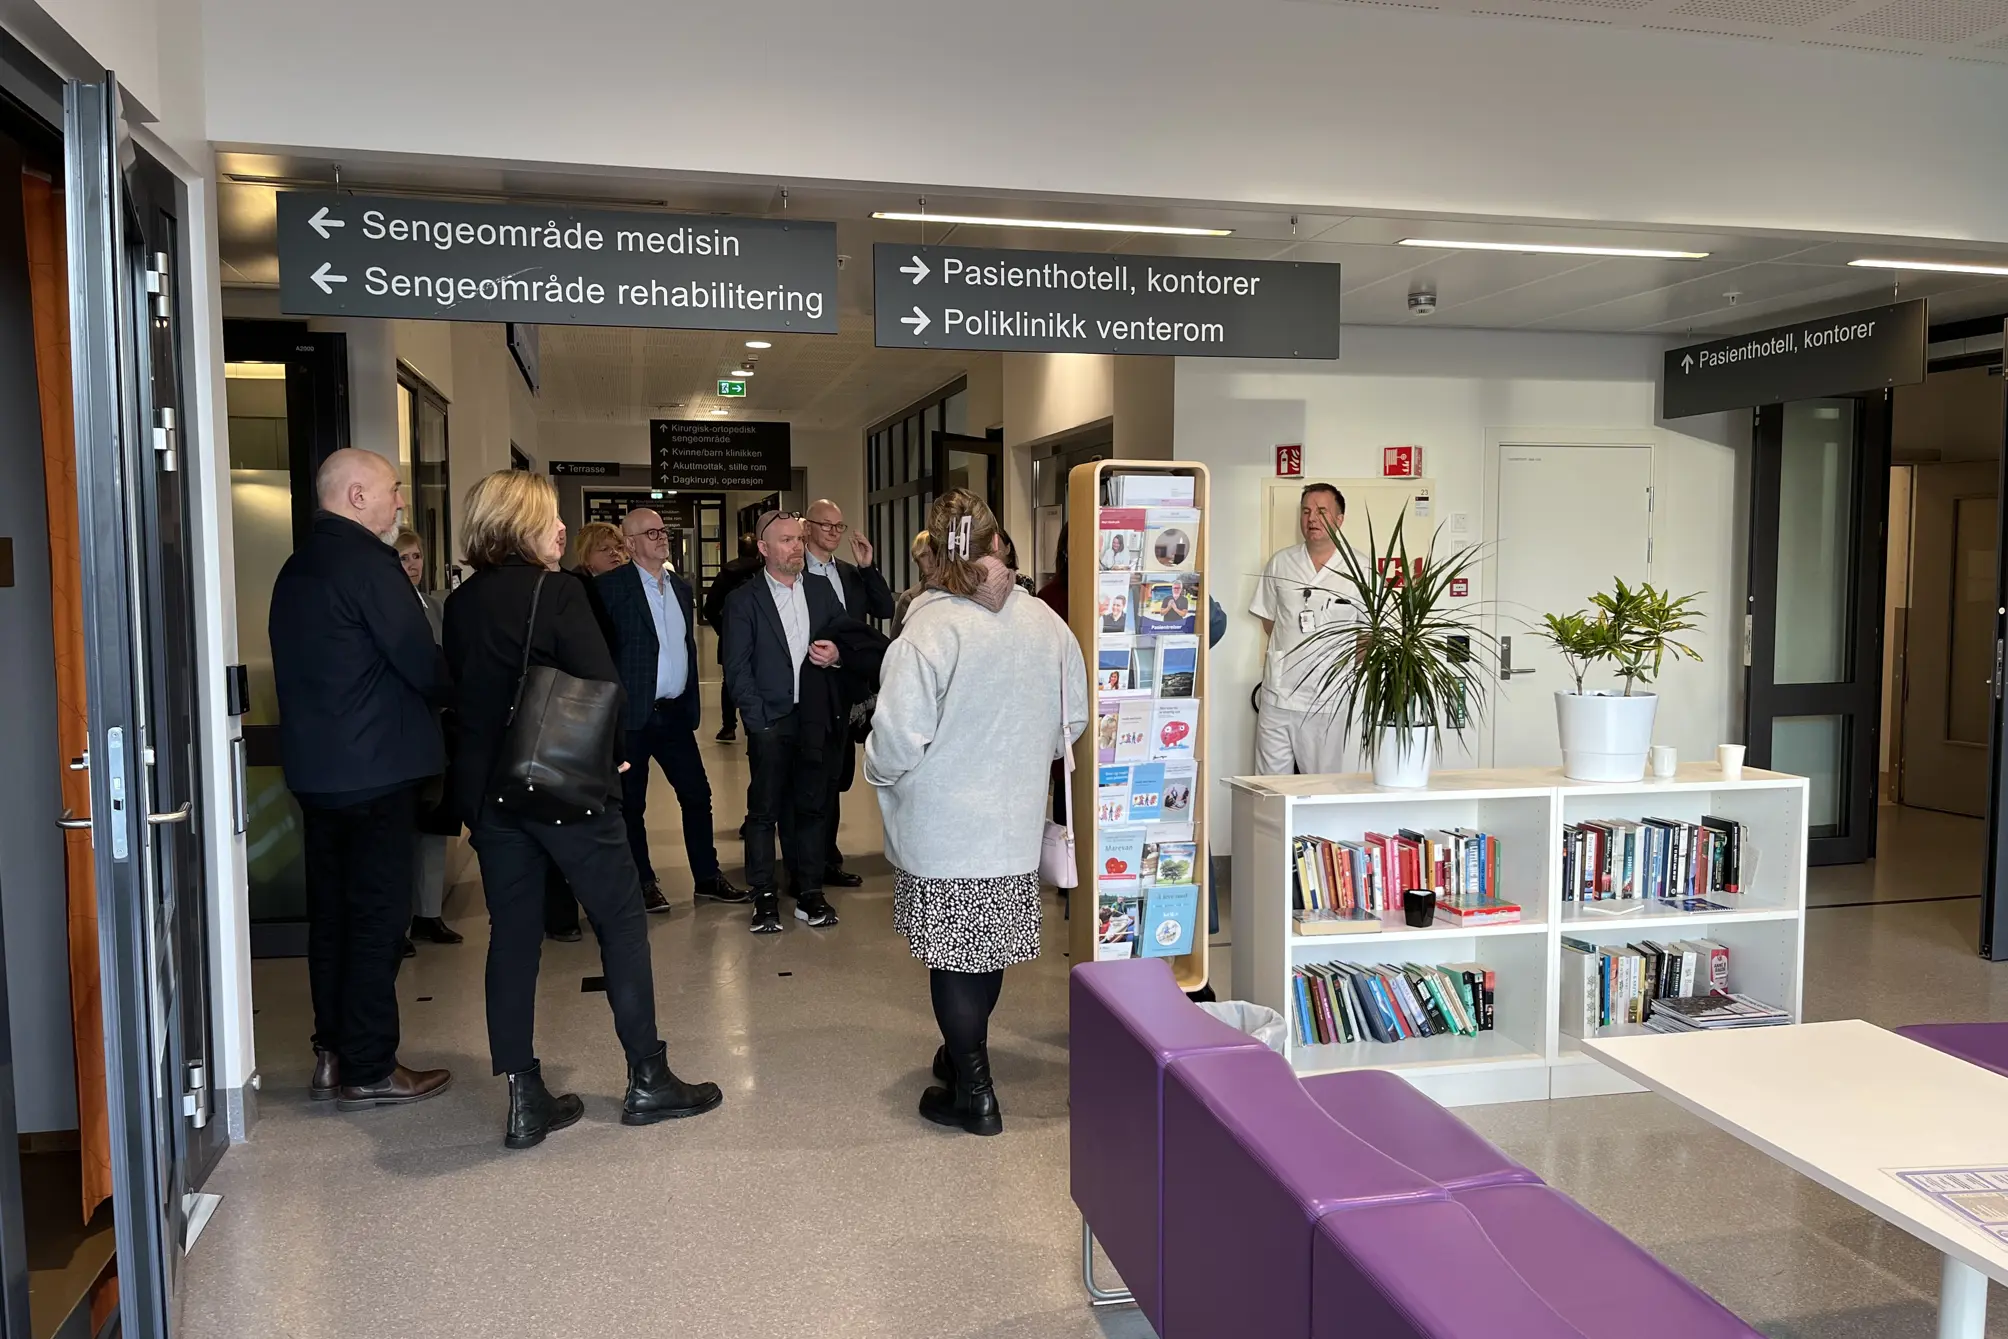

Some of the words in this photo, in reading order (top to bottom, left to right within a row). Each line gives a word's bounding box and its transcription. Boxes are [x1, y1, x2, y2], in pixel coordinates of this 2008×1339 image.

[362, 210, 603, 250] Sengeområde
[617, 227, 739, 256] medisin
[942, 258, 1136, 295] Pasienthotell,
[1147, 267, 1260, 296] kontorer
[364, 266, 605, 306] Sengeområde
[618, 279, 823, 319] rehabilitering
[943, 308, 1087, 339] Poliklinikk
[1096, 318, 1224, 342] venterom
[1699, 333, 1798, 369] Pasienthotell,
[1803, 321, 1876, 349] kontorer
[671, 424, 756, 435] Kirurgisk-ortopedisk
[671, 434, 731, 444] sengeområde
[672, 448, 724, 458] Kvinne/barn
[725, 448, 762, 458] klinikken
[568, 465, 606, 474] Terrasse
[672, 462, 727, 472] Akuttmottak,
[728, 462, 749, 471] stille
[672, 475, 720, 486] Dagkirurgi,
[721, 476, 764, 486] operasjon
